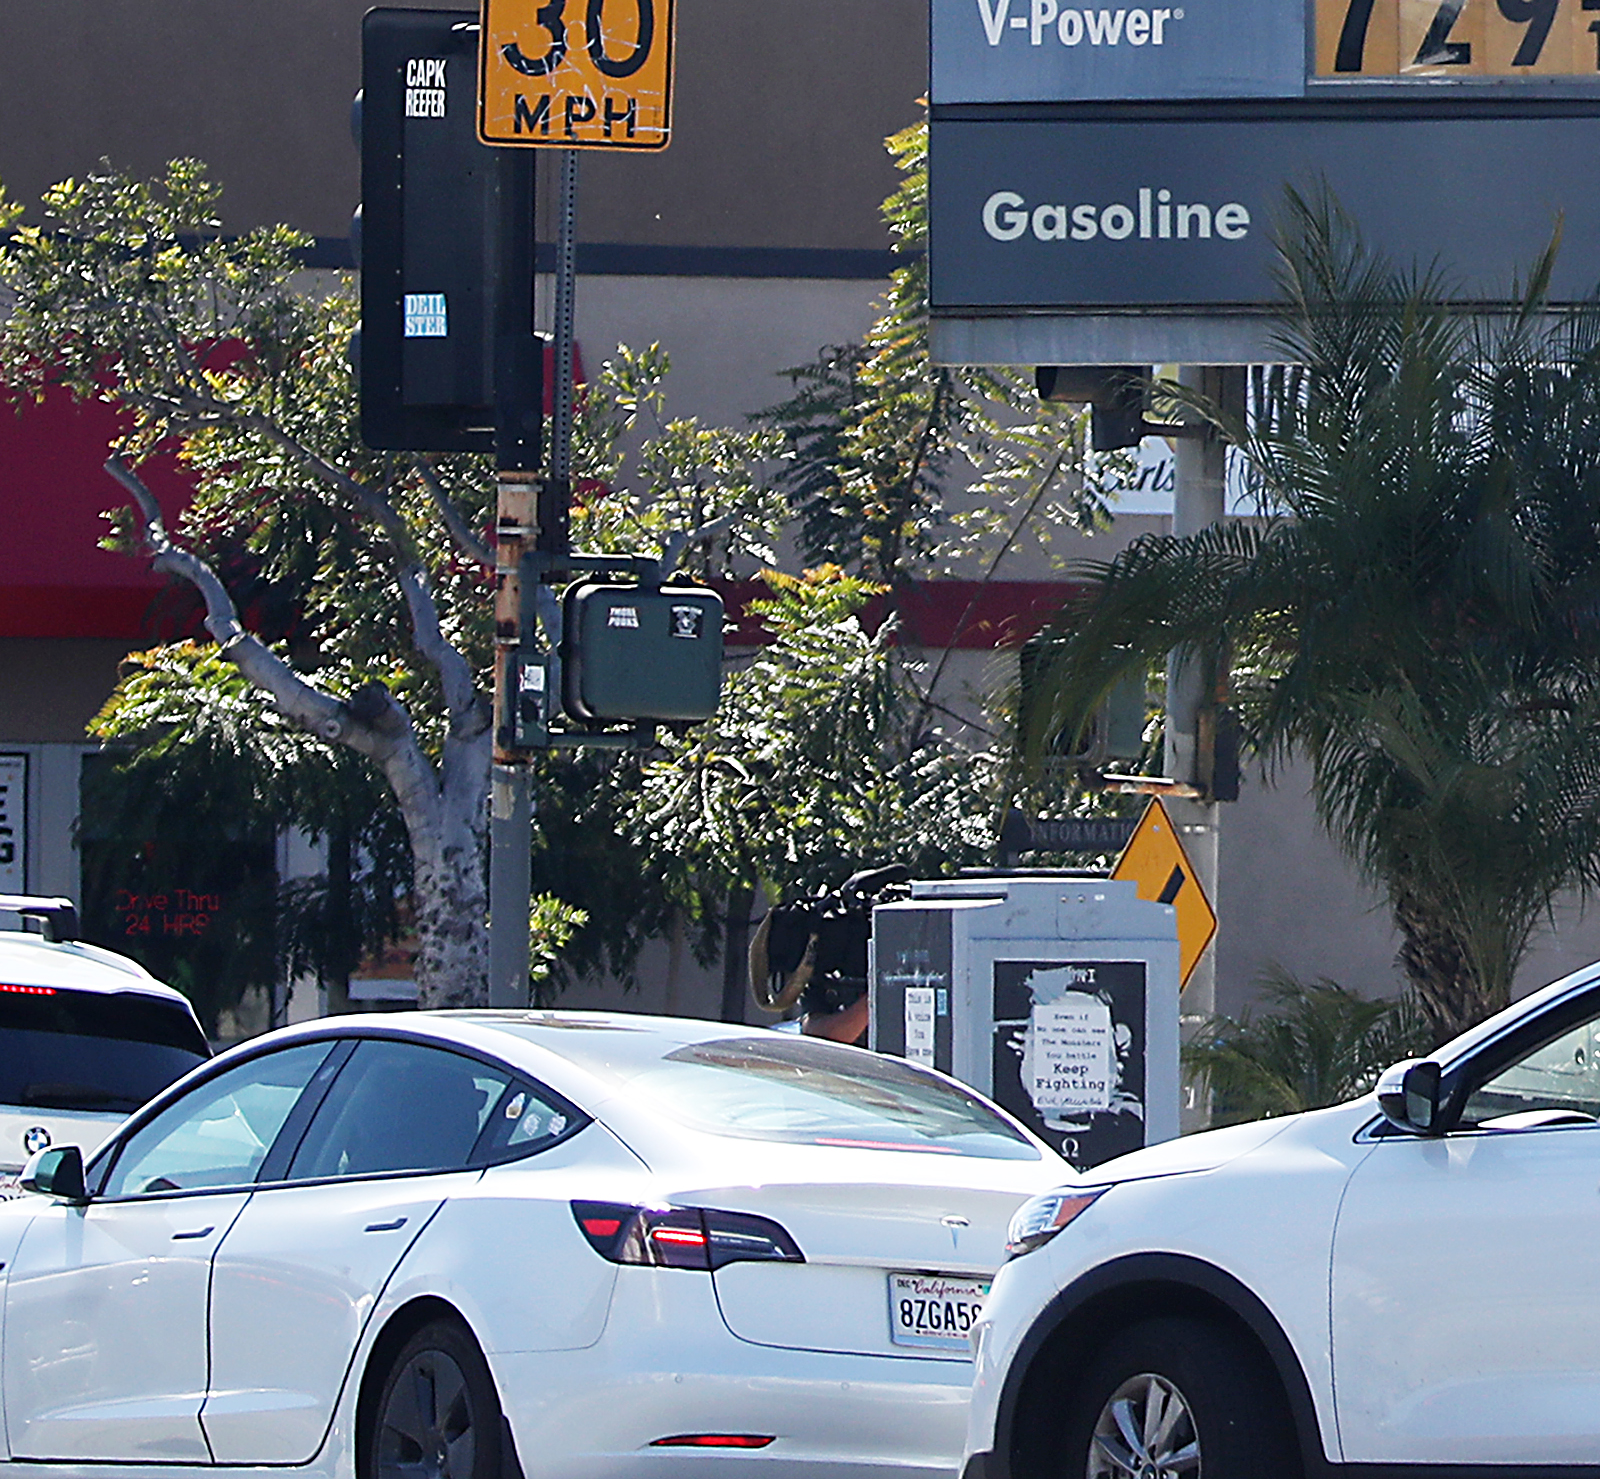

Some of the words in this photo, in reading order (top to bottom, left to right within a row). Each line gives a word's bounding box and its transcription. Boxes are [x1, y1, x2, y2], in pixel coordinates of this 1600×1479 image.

[406, 59, 446, 88] CAPK
[405, 88, 446, 118] REEFER
[513, 93, 637, 138] MPH
[982, 189, 1251, 241] Gasoline
[174, 890, 219, 910] Thru
[126, 914, 150, 935] 24
[1053, 1063, 1089, 1077] Keep
[1036, 1079, 1105, 1091] Fighting
[914, 1279, 982, 1299] California
